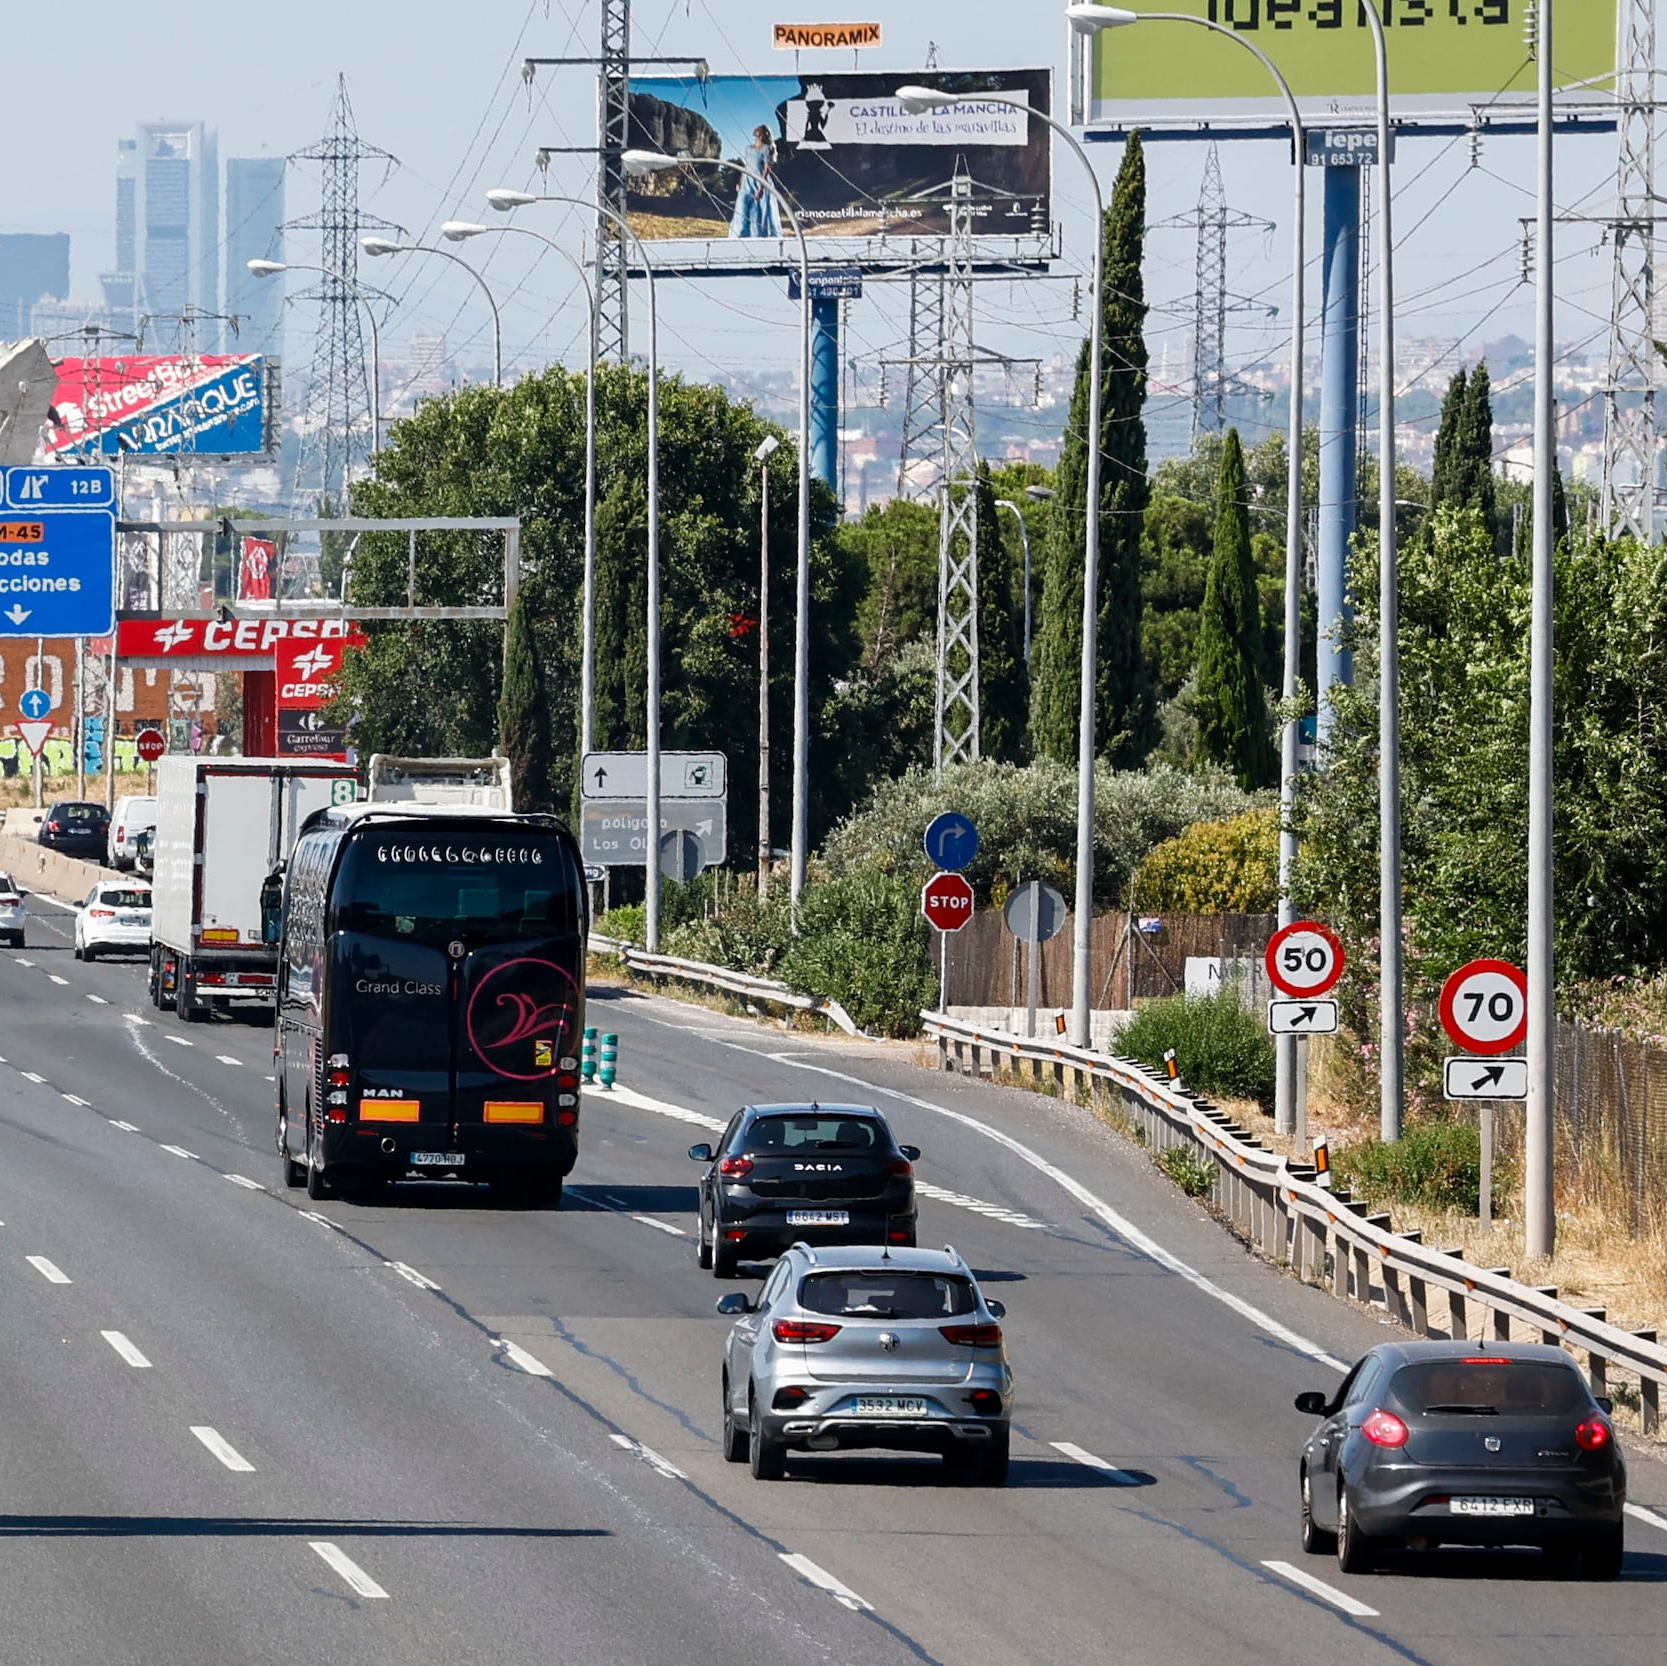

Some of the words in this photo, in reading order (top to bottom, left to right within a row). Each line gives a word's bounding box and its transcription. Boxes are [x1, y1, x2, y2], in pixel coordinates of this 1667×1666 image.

[775, 26, 880, 47] PANORAMIX
[850, 105, 913, 118] CASTILL
[932, 104, 949, 116] LA
[953, 102, 1018, 116] MANCHA
[916, 120, 930, 133] de
[932, 120, 952, 134] las
[1325, 130, 1378, 152] iepe
[1311, 154, 1326, 166] 91
[1331, 153, 1354, 165] 653
[1357, 152, 1373, 164] 72
[71, 480, 102, 494] 12B
[139, 742, 163, 751] STOP
[335, 782, 353, 804] 8
[594, 838, 619, 850] Los
[929, 895, 969, 910] STOP
[1284, 948, 1327, 972] 50
[356, 979, 400, 995] Grand
[404, 979, 442, 996] Class
[1463, 993, 1515, 1023] 70
[363, 1088, 404, 1098] MAN
[794, 1163, 843, 1172] DACIA
[859, 1400, 893, 1412] 3532
[1503, 1499, 1531, 1512] FXR
